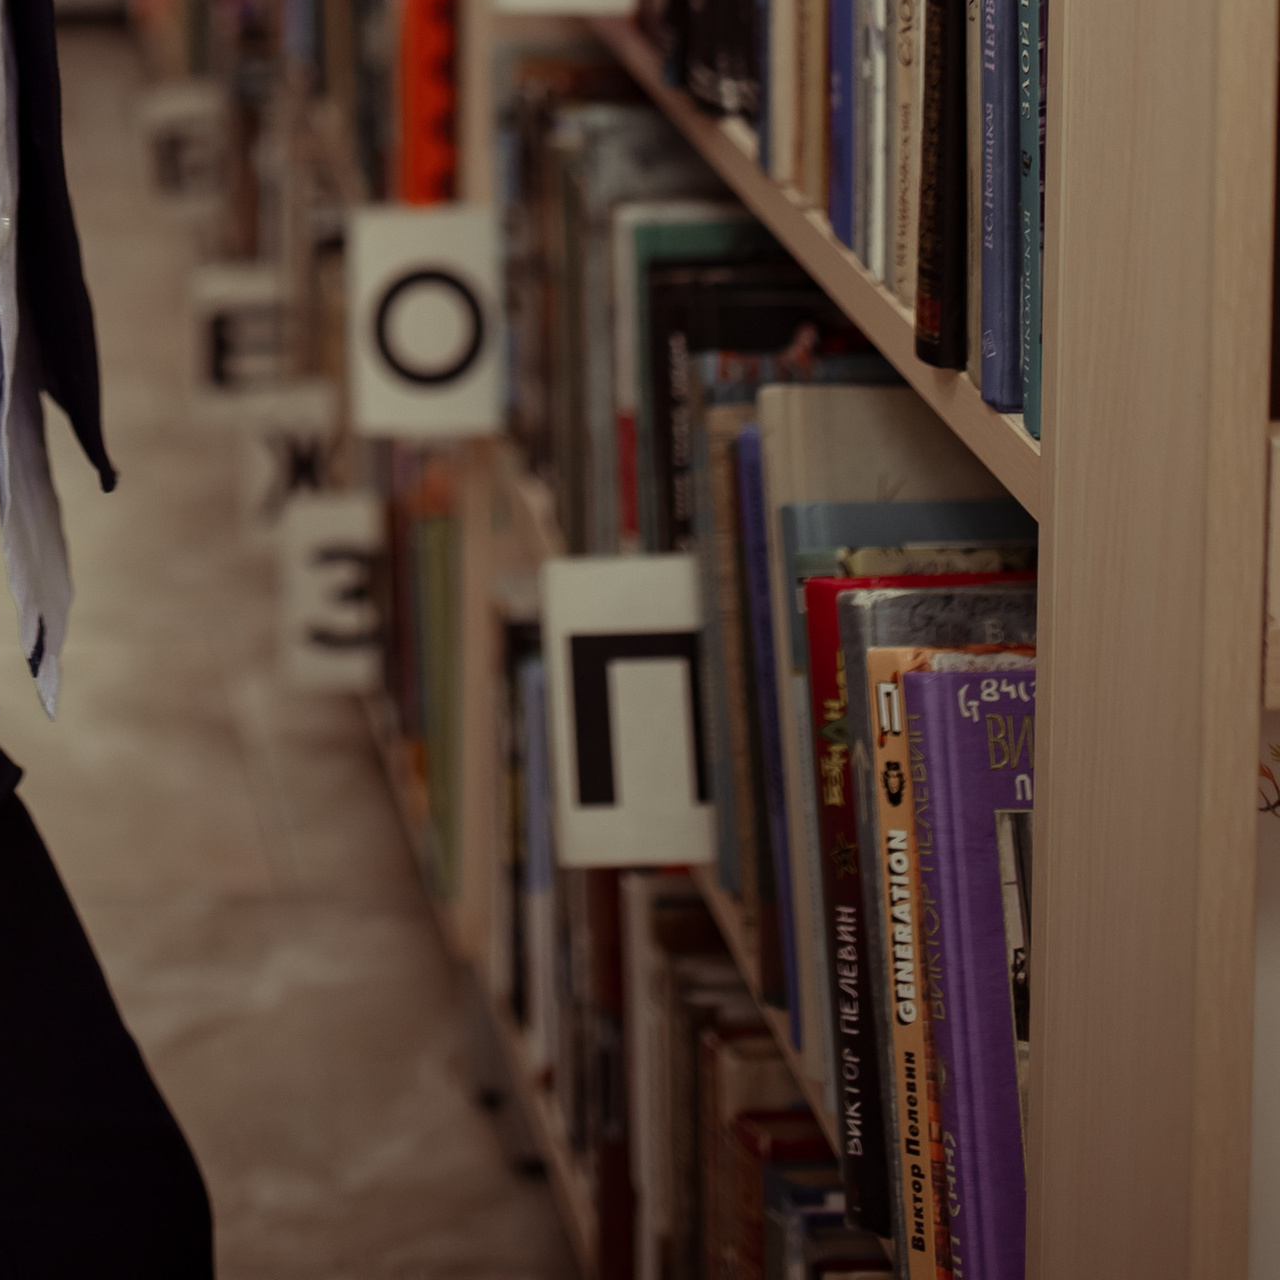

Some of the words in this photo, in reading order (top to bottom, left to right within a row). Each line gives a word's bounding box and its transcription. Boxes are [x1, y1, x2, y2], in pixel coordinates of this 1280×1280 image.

[1017, 21, 1032, 121] ЗЛОЙ
[375, 269, 486, 386] О
[570, 631, 714, 806] П
[835, 903, 861, 1035] ПЕЛЕВИН
[886, 829, 919, 1026] GENERATION
[840, 1047, 864, 1157] ВИКТОР
[901, 1050, 922, 1157] Пелевин
[908, 1163, 927, 1253] Виктор
